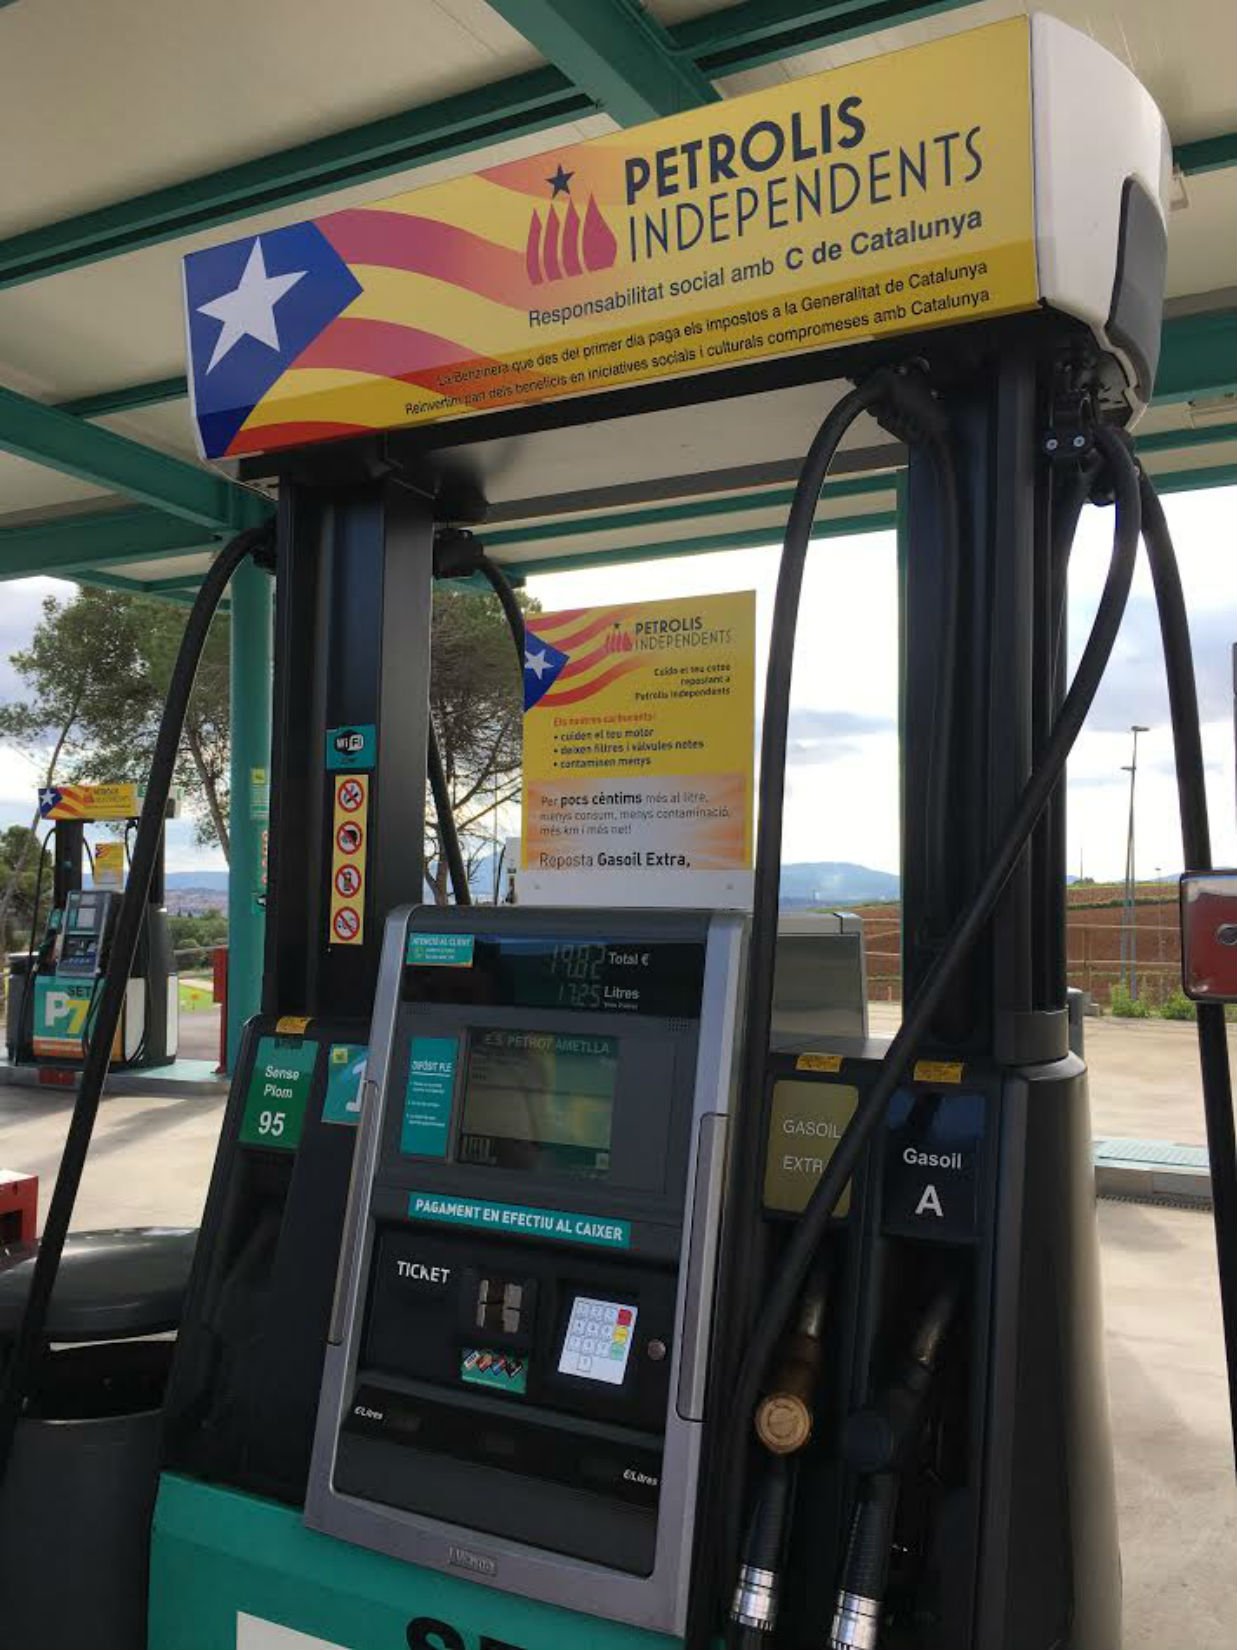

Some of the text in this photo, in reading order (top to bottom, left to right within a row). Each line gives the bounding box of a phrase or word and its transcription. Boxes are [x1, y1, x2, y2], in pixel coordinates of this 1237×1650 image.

[625, 96, 866, 205] PETROLIS
[629, 126, 983, 263] INDEPENDENTS
[529, 210, 982, 328] Responsabilitat social amb C de Catalunya
[511, 358, 534, 373] que
[537, 353, 558, 366] des
[562, 347, 580, 361] del
[583, 340, 622, 359] primer
[626, 333, 646, 349] dia
[649, 326, 681, 347] paga
[684, 320, 703, 337] els
[706, 309, 768, 332] impostos
[773, 306, 781, 317] a
[784, 299, 798, 316] la
[801, 282, 880, 312] Generalitat
[885, 279, 904, 295] de
[908, 260, 988, 289] Catalunya
[570, 372, 585, 383] en
[588, 357, 648, 381] iniciatives
[652, 348, 696, 368] socials
[707, 333, 764, 357] culturals
[767, 313, 870, 345] compromeses
[873, 306, 906, 325] amb
[911, 288, 990, 315] Catalunya
[635, 616, 703, 635] PETROLIS
[635, 630, 731, 651] INDEPENDENTS
[595, 730, 603, 739] el
[625, 728, 654, 737] motor
[541, 796, 558, 806] Per
[561, 794, 589, 808] pocs
[564, 824, 580, 835] km
[540, 852, 593, 870] Reposta
[597, 851, 641, 866] Gasoil
[608, 951, 638, 965] Total
[604, 986, 640, 999] Litres
[265, 1065, 300, 1081] Sense
[263, 1084, 293, 1099] Plom
[258, 1111, 286, 1137] 95
[783, 1119, 842, 1139] GASOIL
[783, 1155, 830, 1174] EXTR
[903, 1148, 962, 1170] Gasoil
[915, 1184, 944, 1217] A
[415, 1198, 623, 1241] PAGAMENT EN EFECTIU AL CAIXER
[397, 1260, 451, 1285] TICKET
